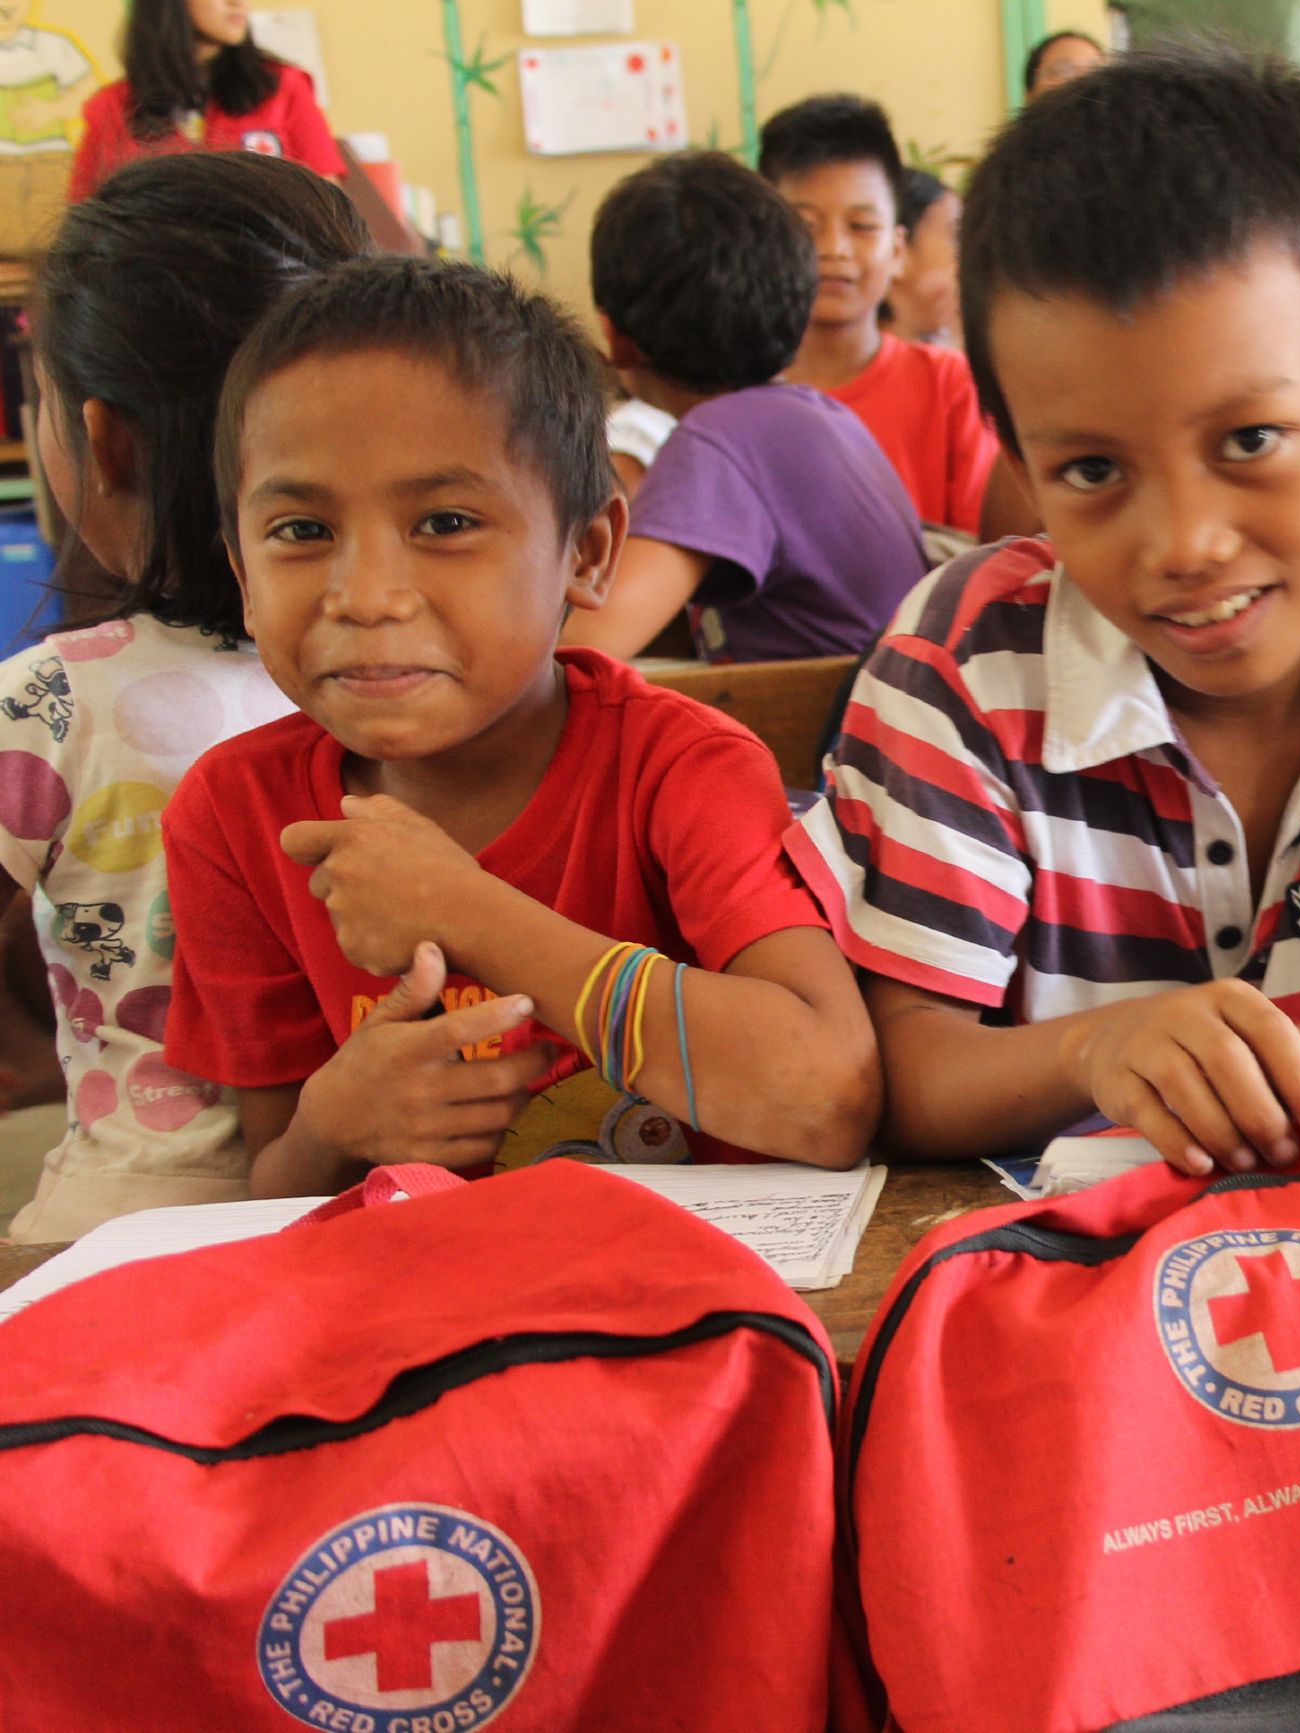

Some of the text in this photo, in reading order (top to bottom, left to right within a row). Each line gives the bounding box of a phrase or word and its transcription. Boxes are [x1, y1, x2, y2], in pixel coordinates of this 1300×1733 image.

[1161, 1230, 1280, 1309] PHILIPPINE
[1164, 1318, 1207, 1387] THE
[1219, 1386, 1286, 1421] RED
[1102, 1517, 1174, 1554] ALWAYS
[1174, 1502, 1241, 1536] FIRST,
[265, 1514, 528, 1700] THE PHILIPPINE NATIONAL
[308, 1688, 493, 1733] RED CROSS
